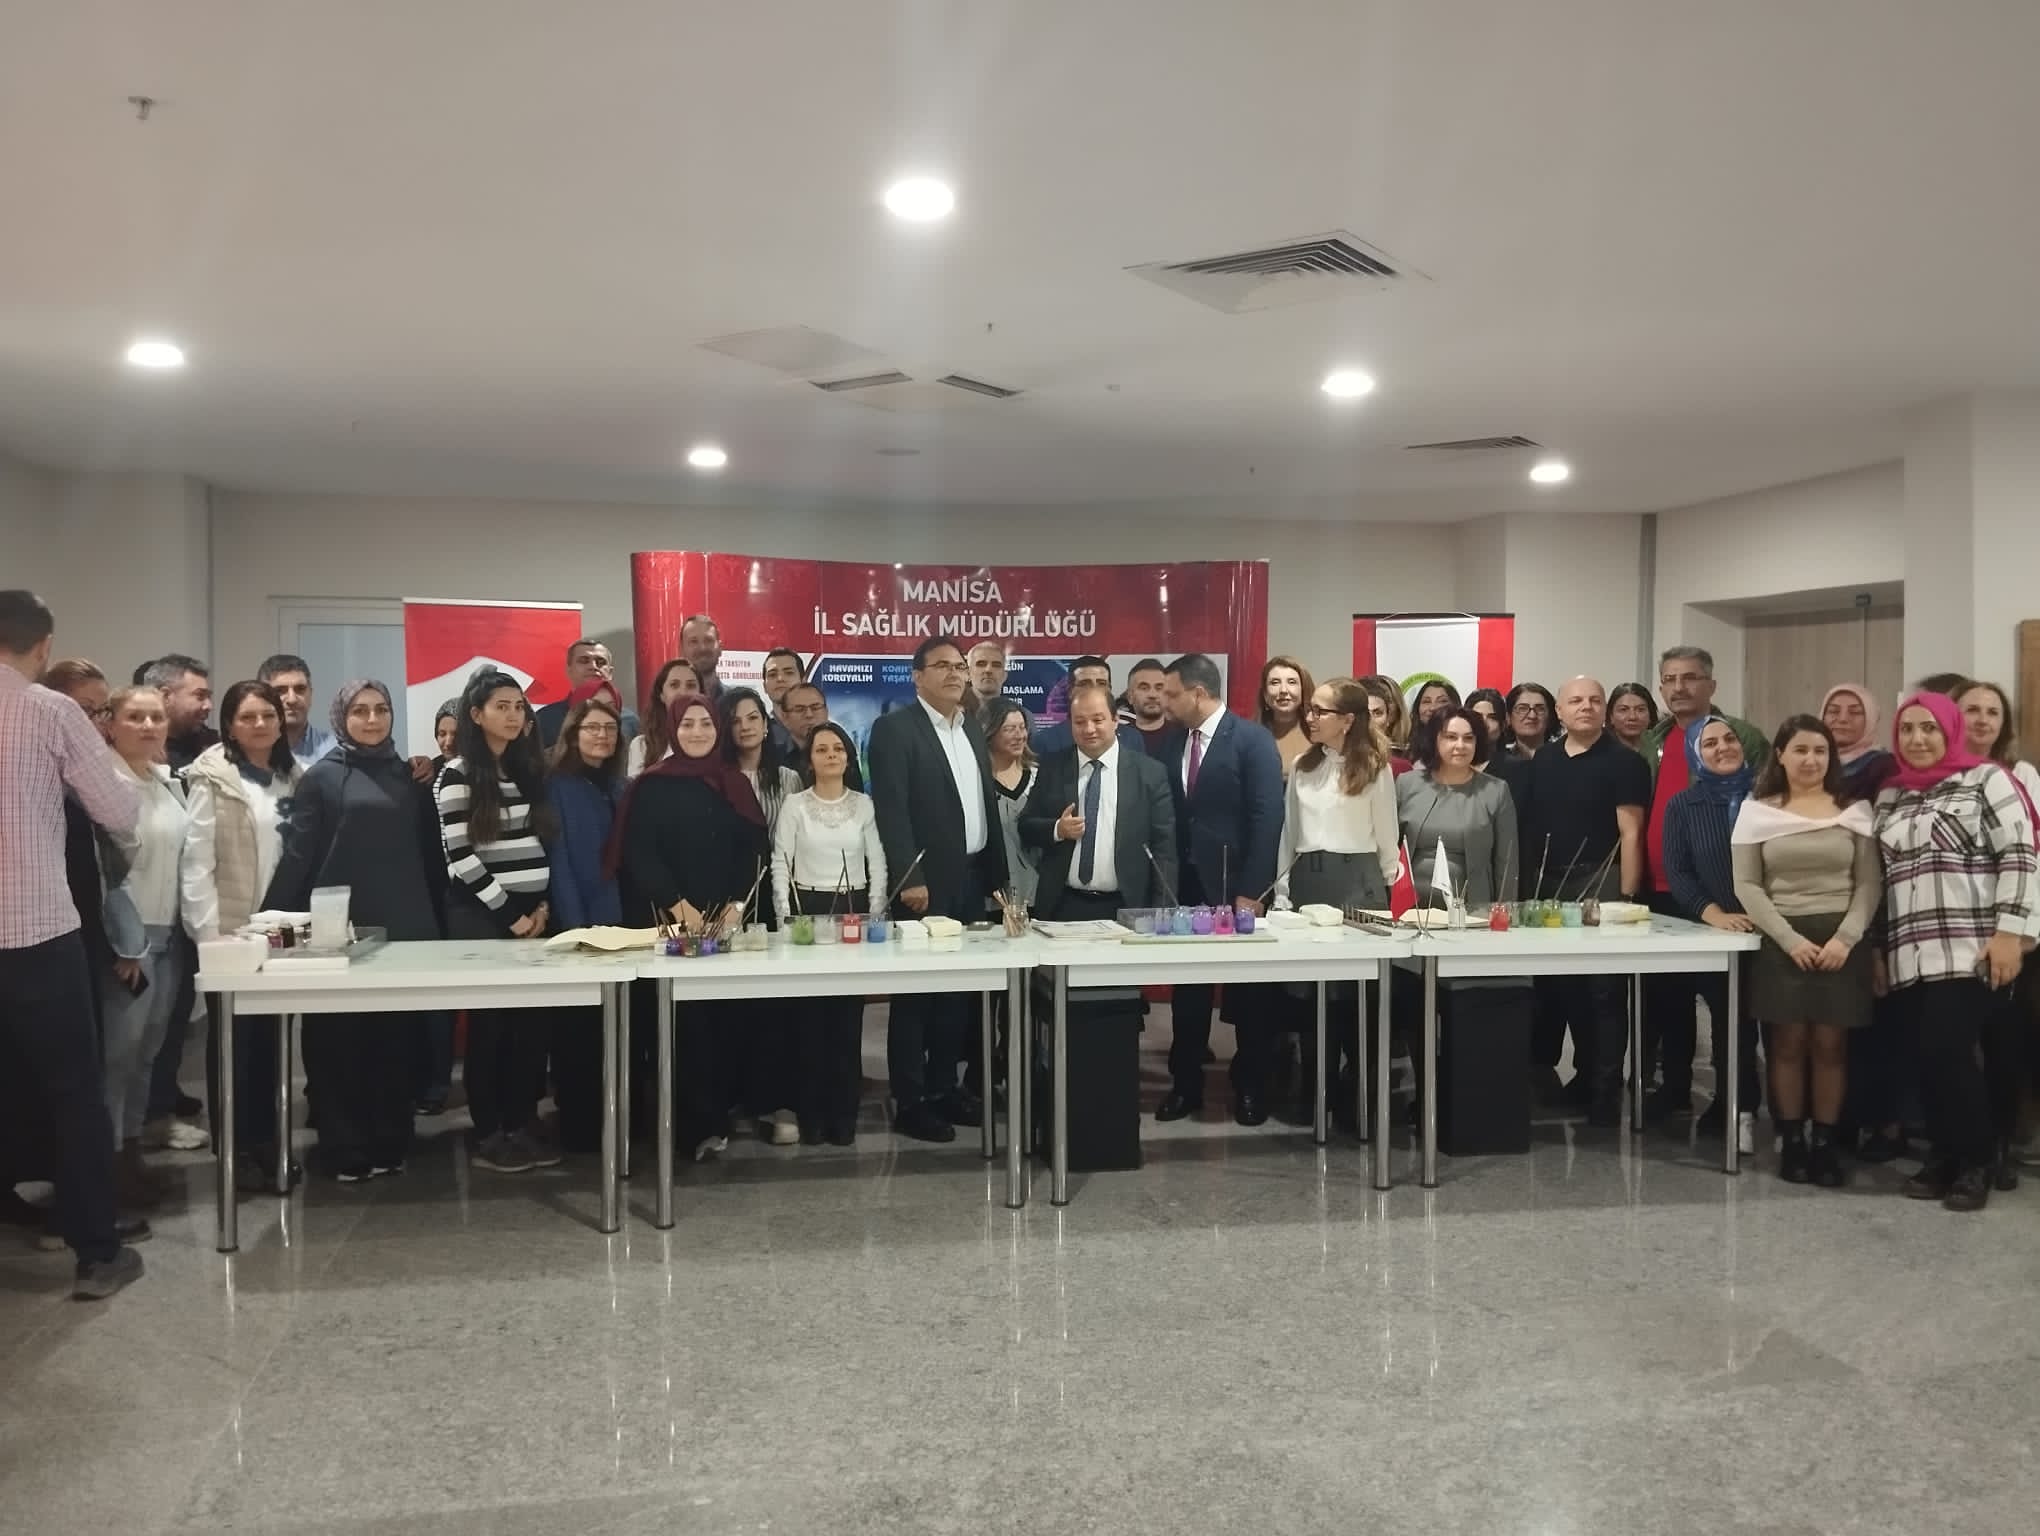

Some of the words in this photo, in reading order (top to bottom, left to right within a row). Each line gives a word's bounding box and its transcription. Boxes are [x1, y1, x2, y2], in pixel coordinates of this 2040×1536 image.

[903, 576, 1003, 603] MANİSA
[814, 605, 836, 635] İL
[842, 608, 931, 637] SAĞLIK
[938, 609, 1096, 637] MÜDÜRLÜĞÜ
[1003, 686, 1044, 696] BAŞLAMA
